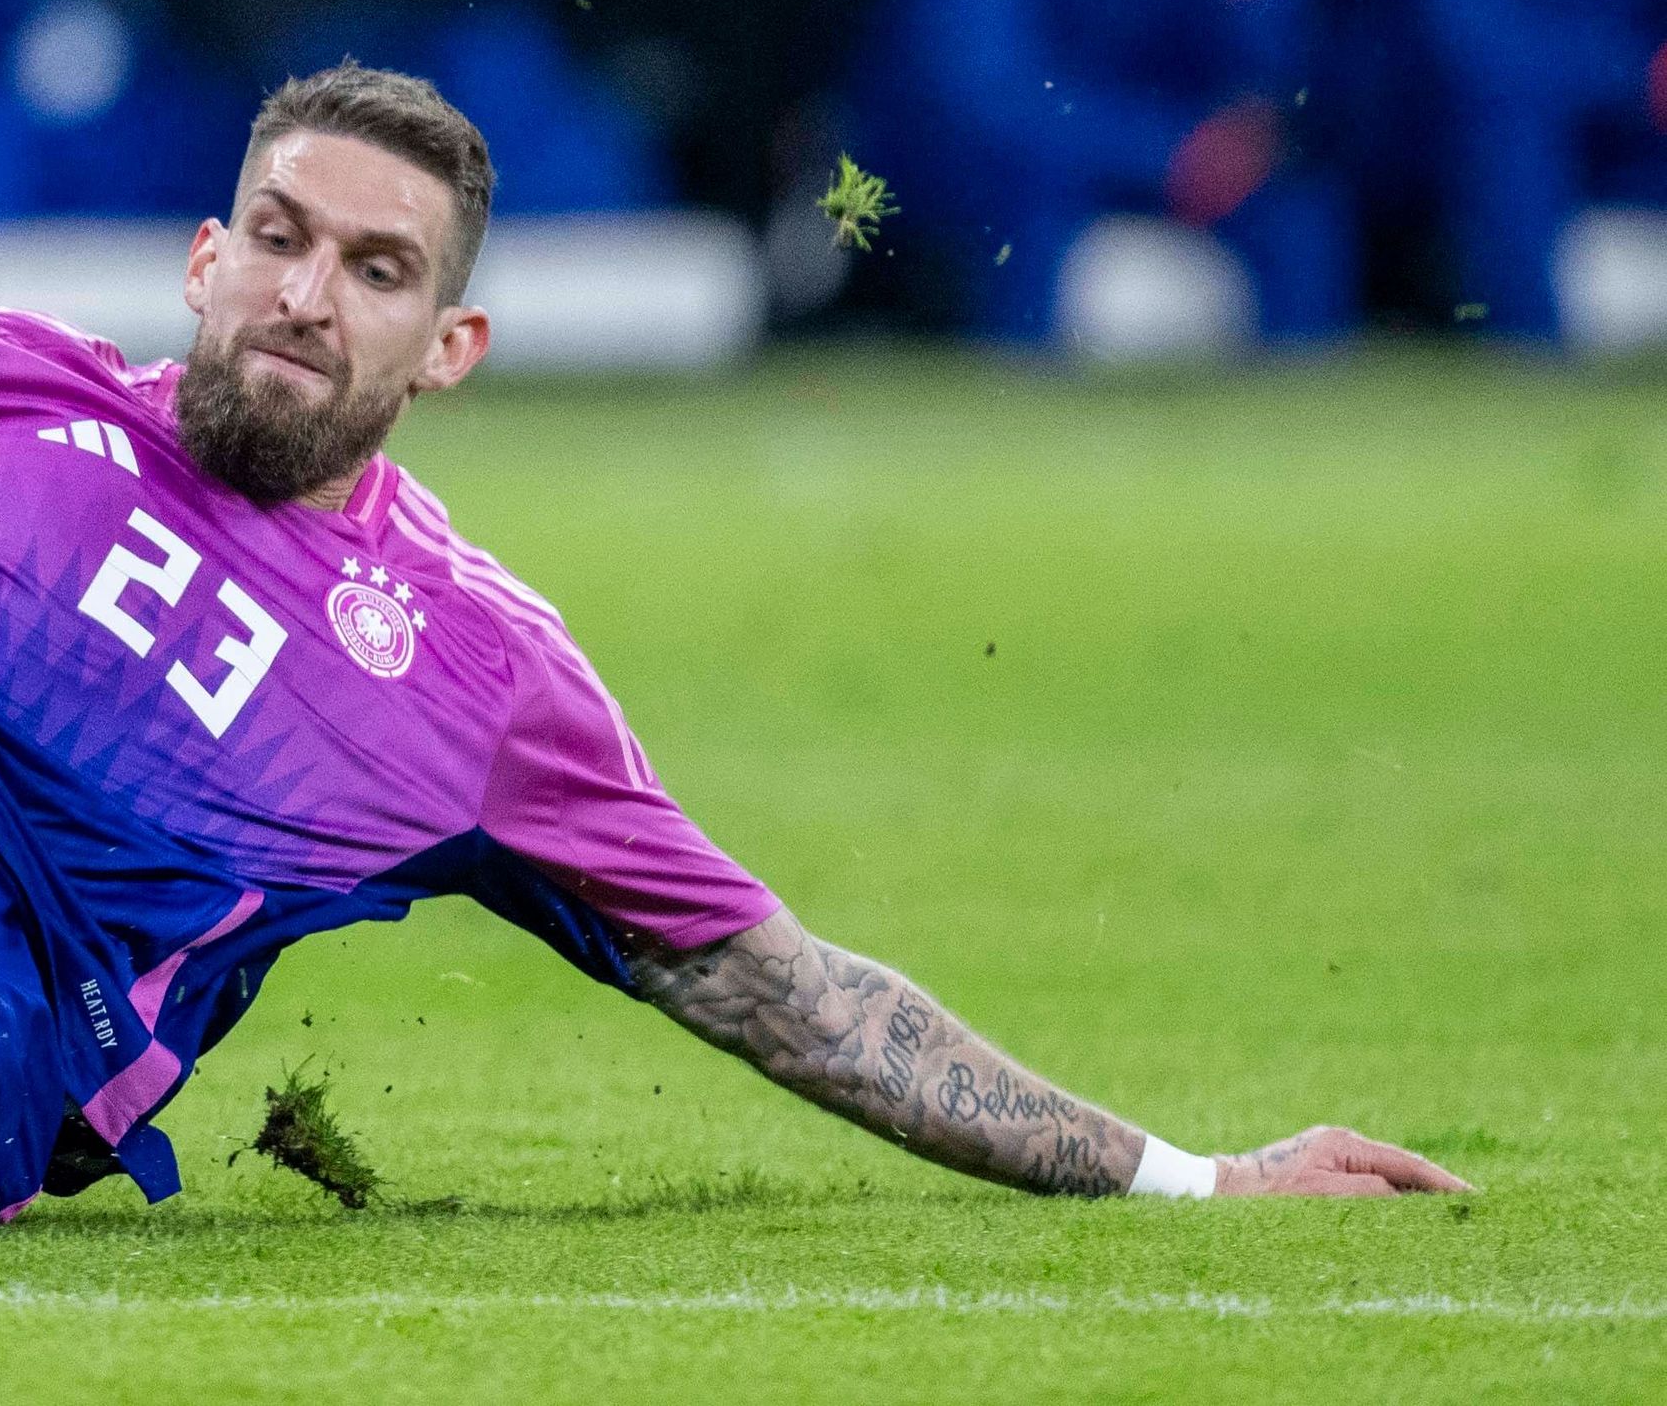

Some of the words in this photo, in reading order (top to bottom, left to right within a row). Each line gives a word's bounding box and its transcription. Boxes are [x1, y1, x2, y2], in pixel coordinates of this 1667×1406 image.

[77, 507, 288, 739] 23
[80, 978, 118, 1049] HEAT.RDY
[938, 1060, 1079, 1134] Believe
